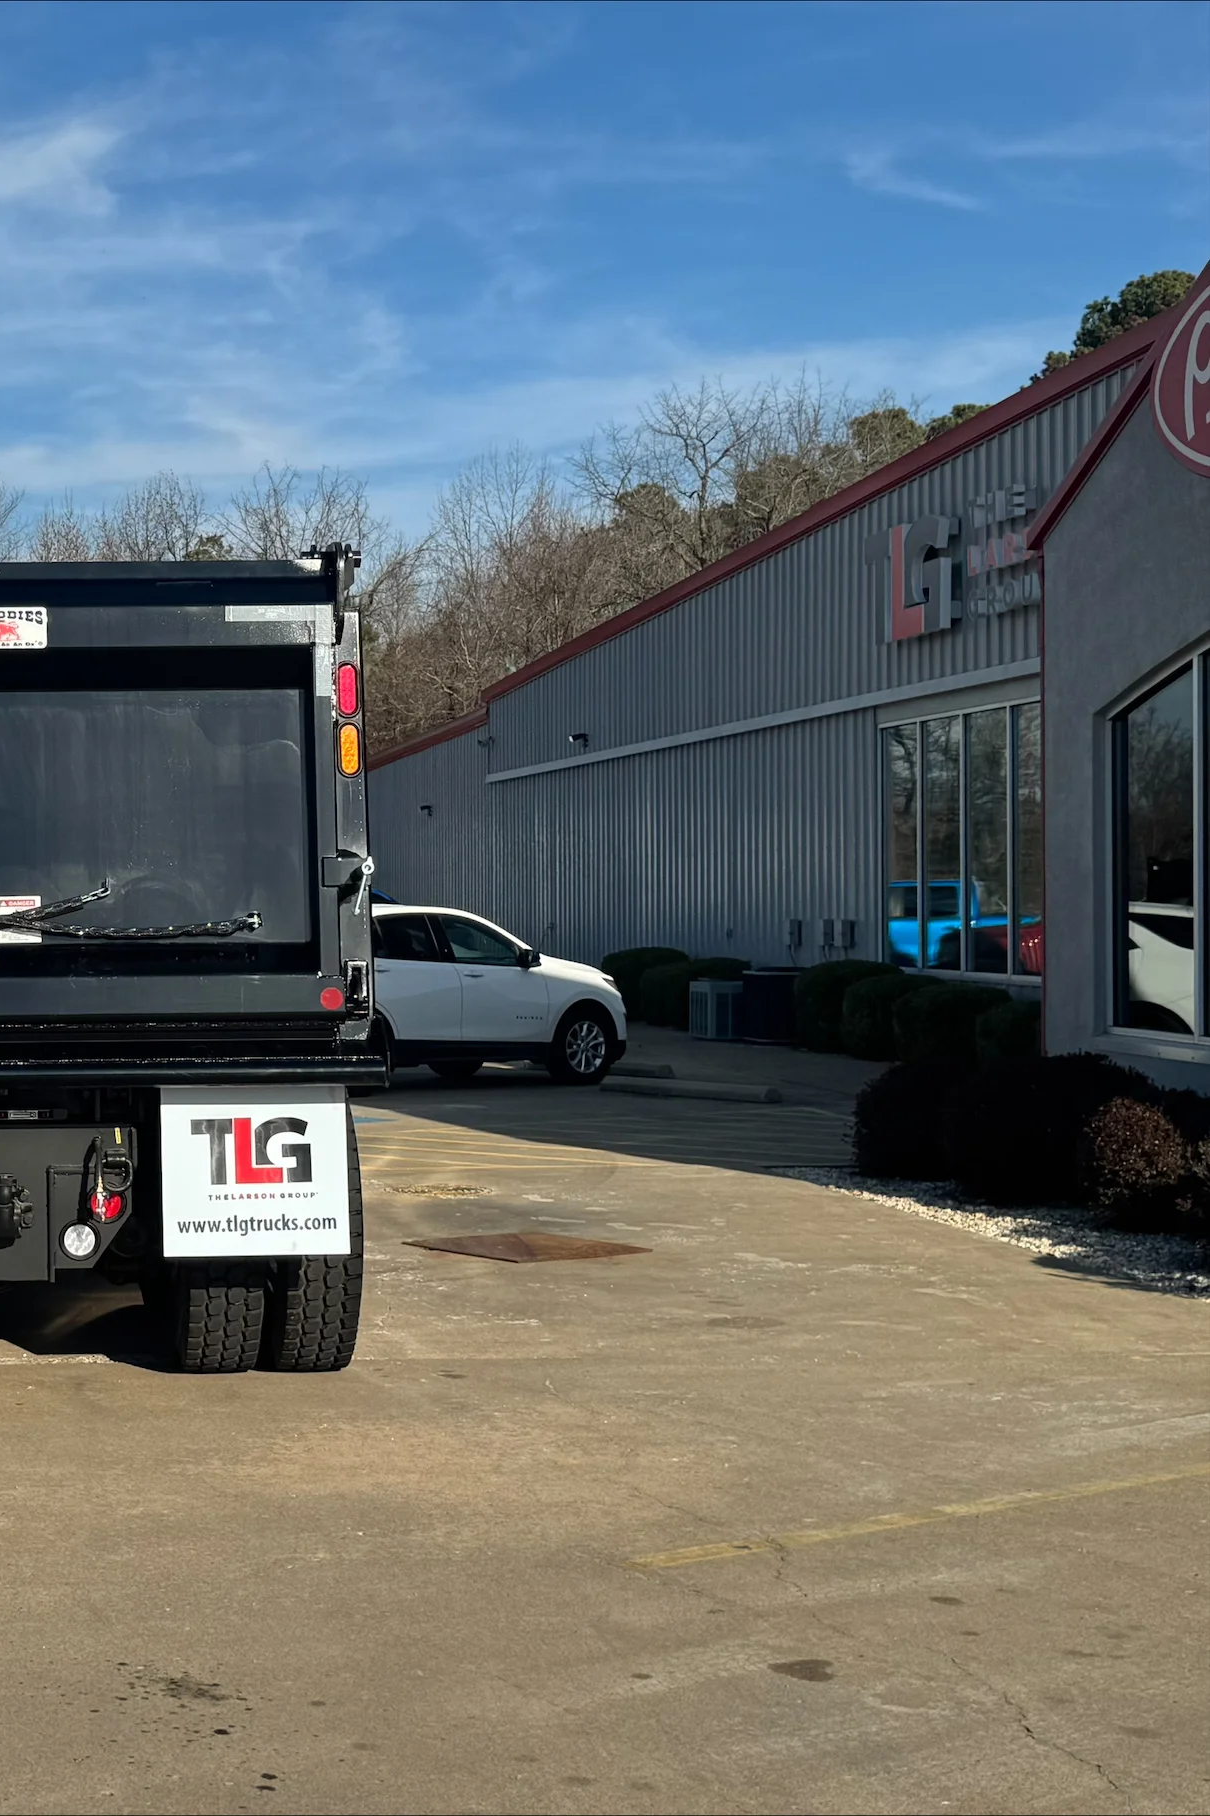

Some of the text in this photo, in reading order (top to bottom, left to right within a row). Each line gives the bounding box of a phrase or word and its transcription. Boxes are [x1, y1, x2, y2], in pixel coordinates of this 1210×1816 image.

[864, 514, 952, 646] TLG
[190, 1117, 313, 1185] TLG
[280, 1191, 315, 1199] GROUP
[177, 1214, 338, 1236] www.tlgtrucks.com
